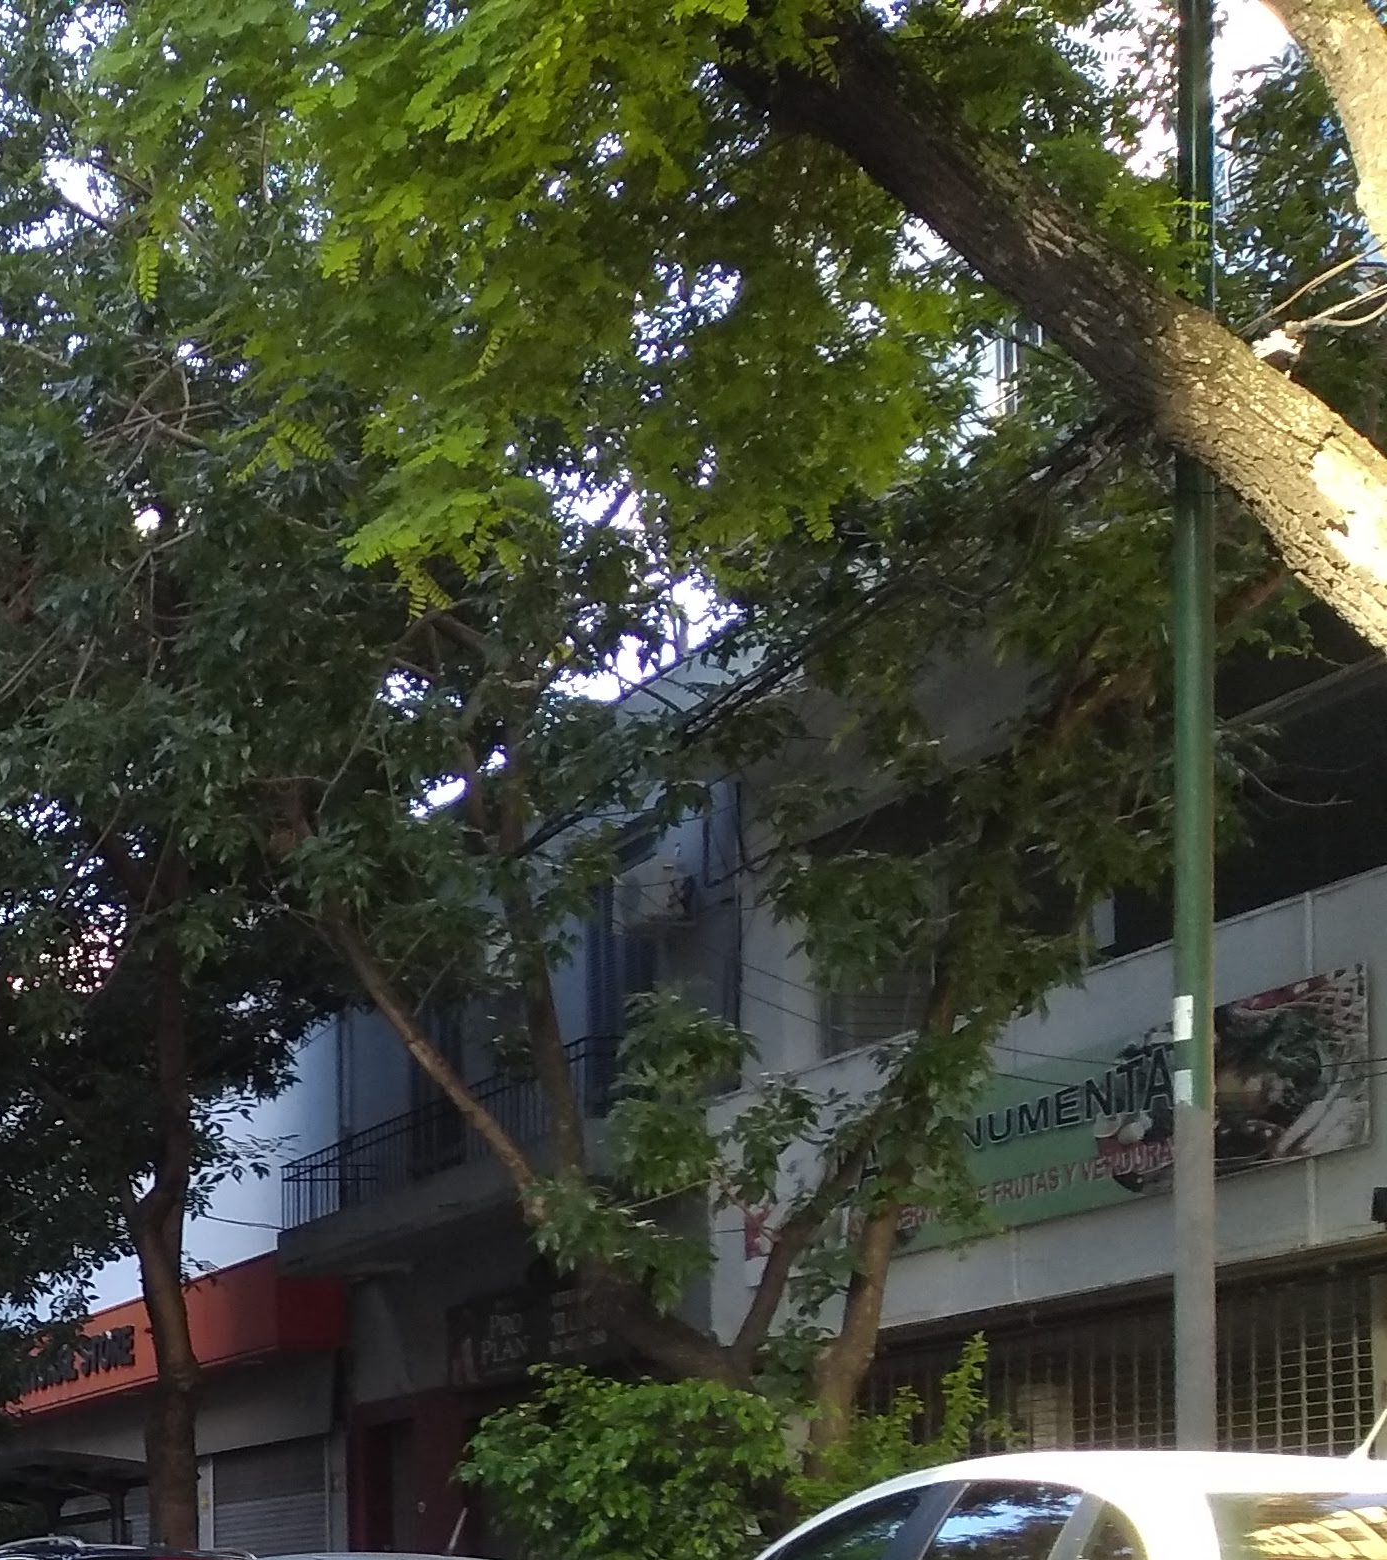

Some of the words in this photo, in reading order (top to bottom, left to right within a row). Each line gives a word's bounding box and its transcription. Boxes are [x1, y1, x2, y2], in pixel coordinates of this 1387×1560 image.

[993, 1166, 1061, 1205] FRUTAS
[1063, 1163, 1078, 1185] Y
[1084, 1137, 1174, 1181] VERDURA
